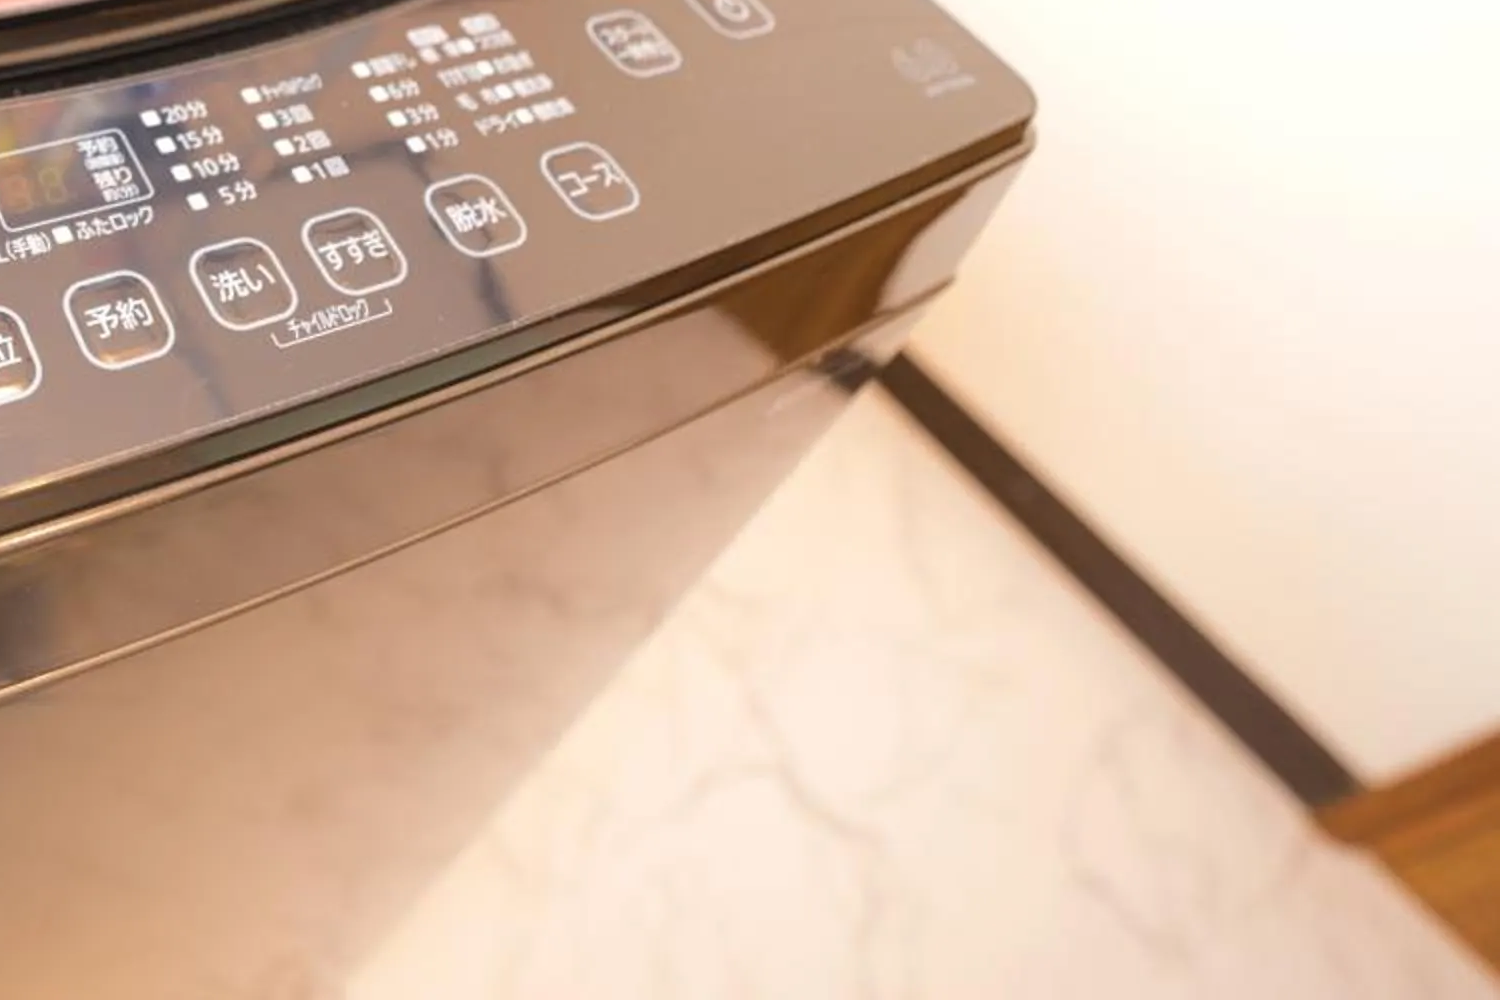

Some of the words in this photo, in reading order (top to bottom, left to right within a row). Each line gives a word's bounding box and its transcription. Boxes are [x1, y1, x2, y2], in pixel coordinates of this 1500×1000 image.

[160, 99, 209, 125] 20分
[176, 125, 225, 151] 15分
[424, 127, 459, 150] 1分
[191, 152, 241, 179] 10分
[557, 161, 626, 197] コース
[216, 178, 259, 206] 5分
[74, 204, 155, 241] ふたロック
[445, 195, 509, 234] 脱水
[317, 229, 389, 272] すすぎ
[210, 263, 278, 304] 洗い
[84, 296, 156, 341] 予約
